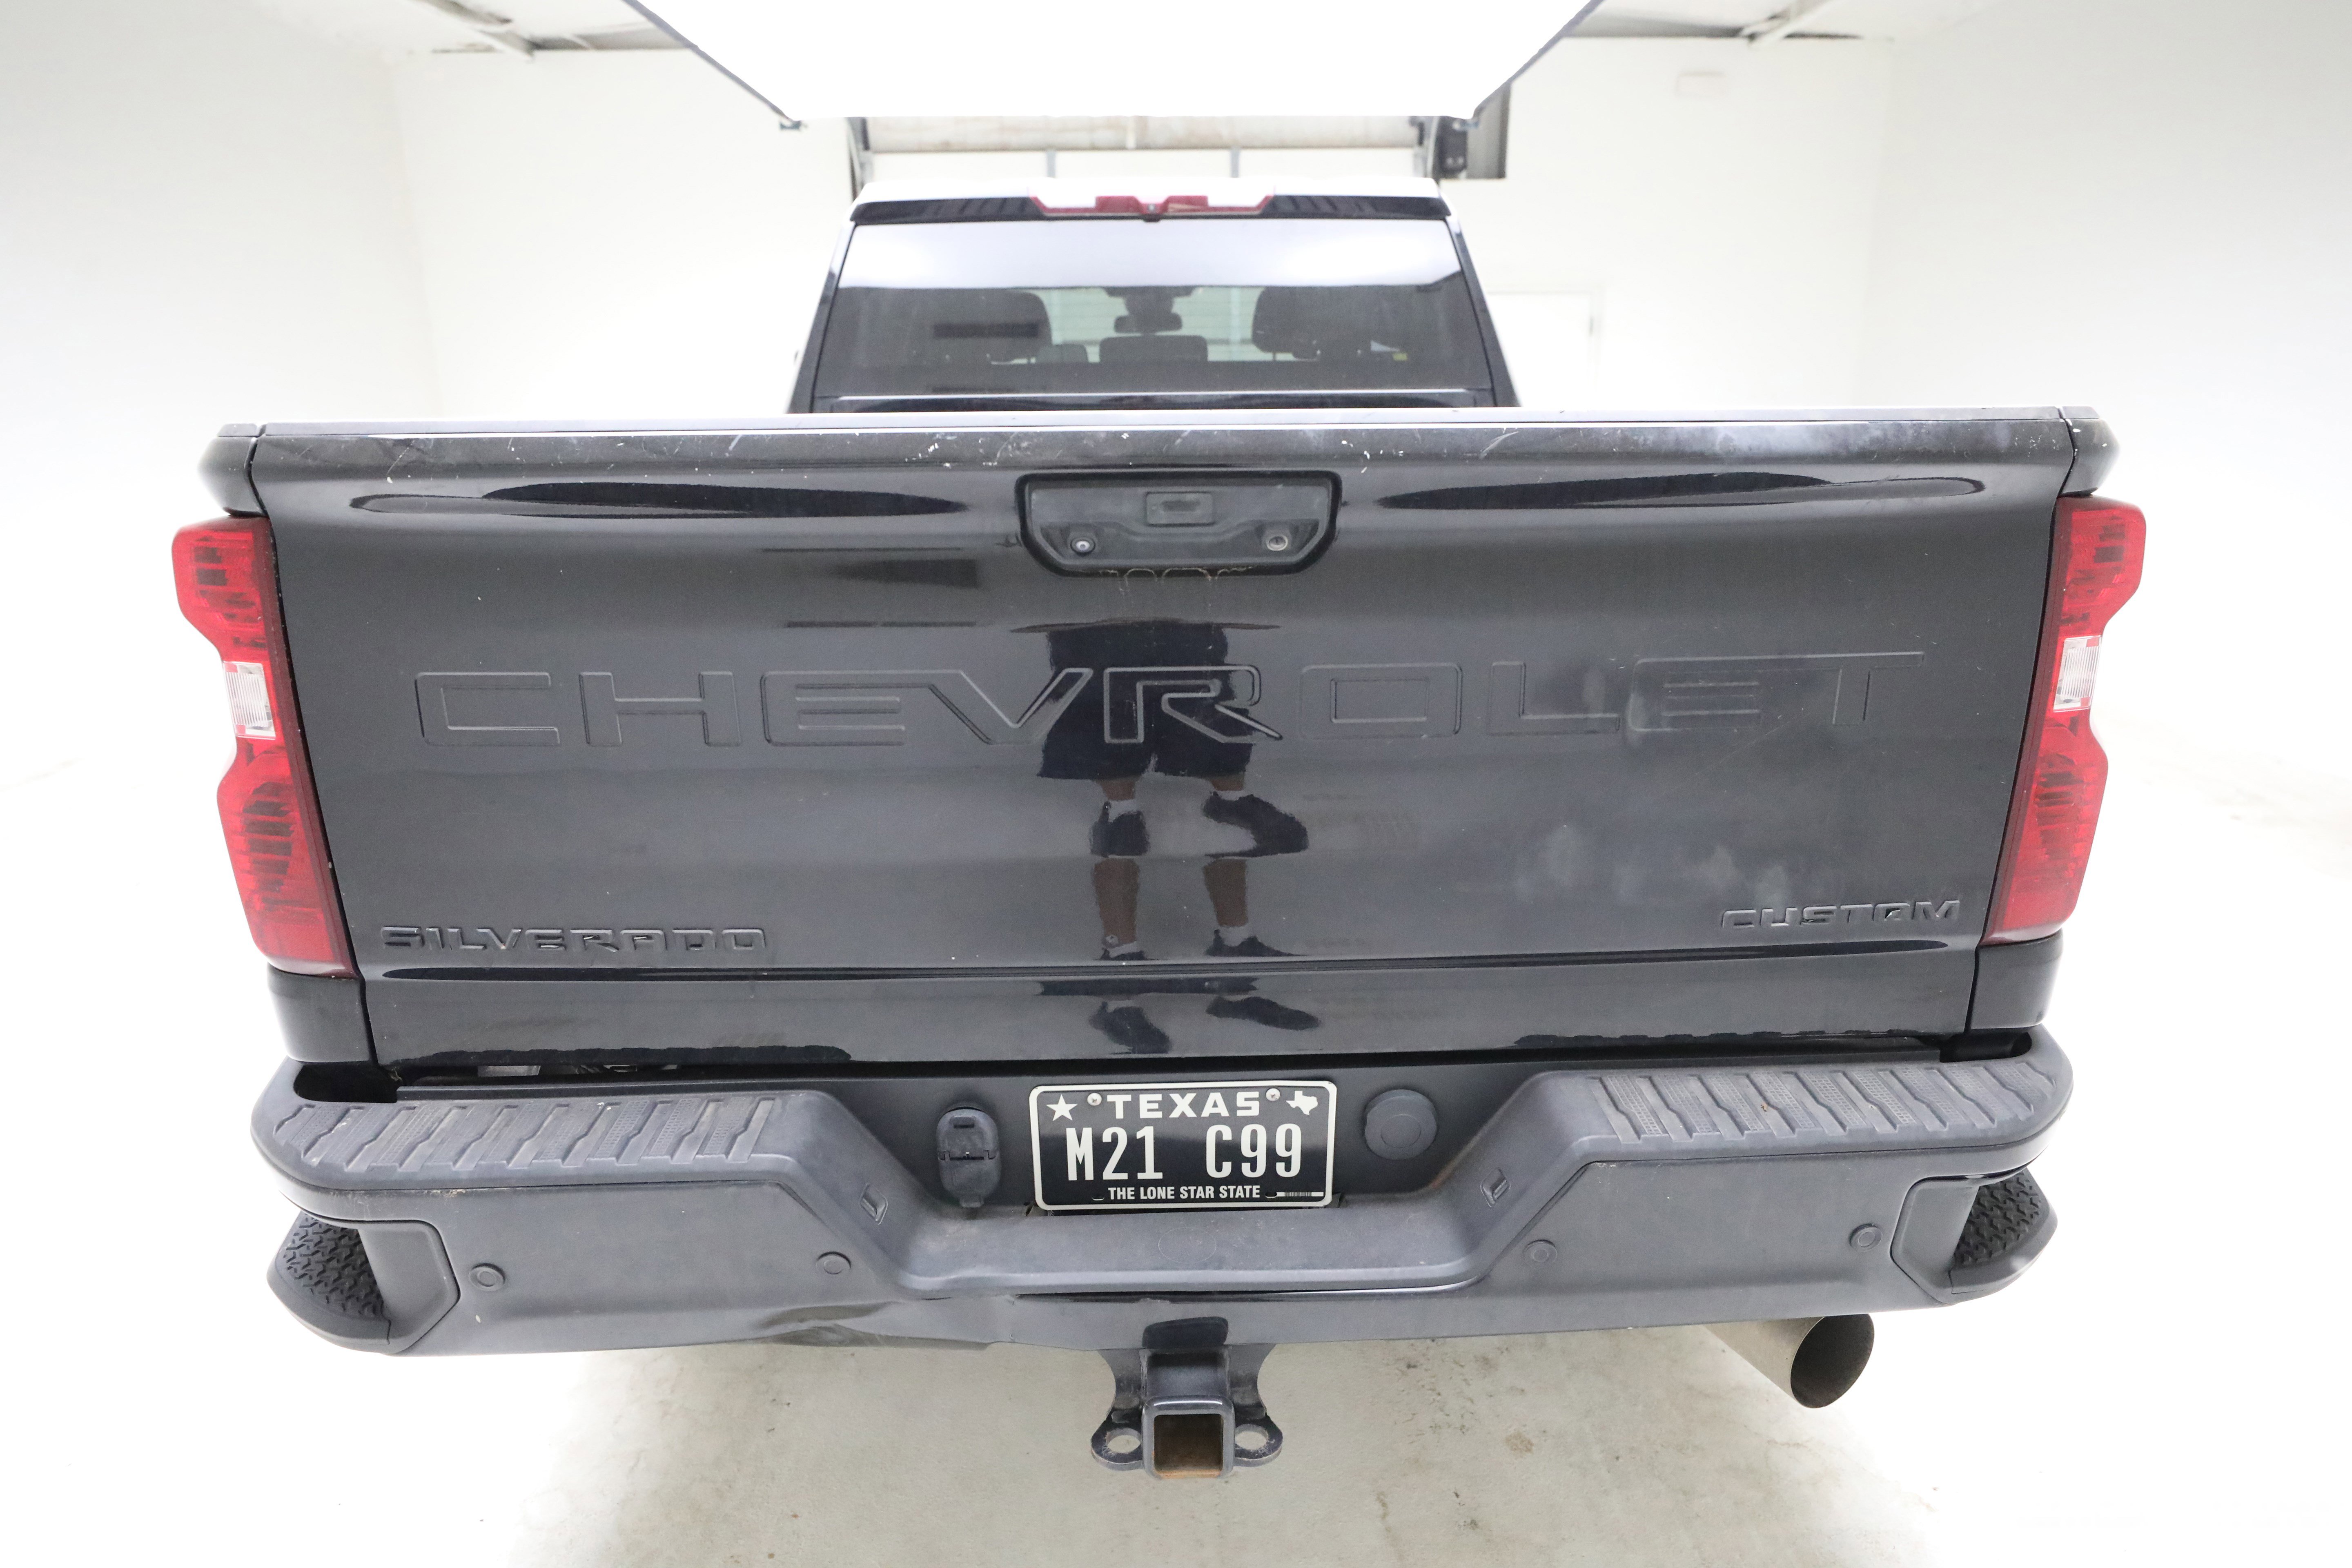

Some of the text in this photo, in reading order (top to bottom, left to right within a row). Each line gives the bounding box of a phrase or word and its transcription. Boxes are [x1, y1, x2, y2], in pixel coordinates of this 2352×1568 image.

[414, 650, 1925, 747] CHEVROLET
[1722, 900, 1960, 928] CUSTOM
[380, 926, 766, 953] SILVERADO
[1107, 1091, 1260, 1118] TEXAS
[1066, 1123, 1302, 1181] M21 C99
[1108, 1185, 1261, 1200] THE LONE STAR STATE
